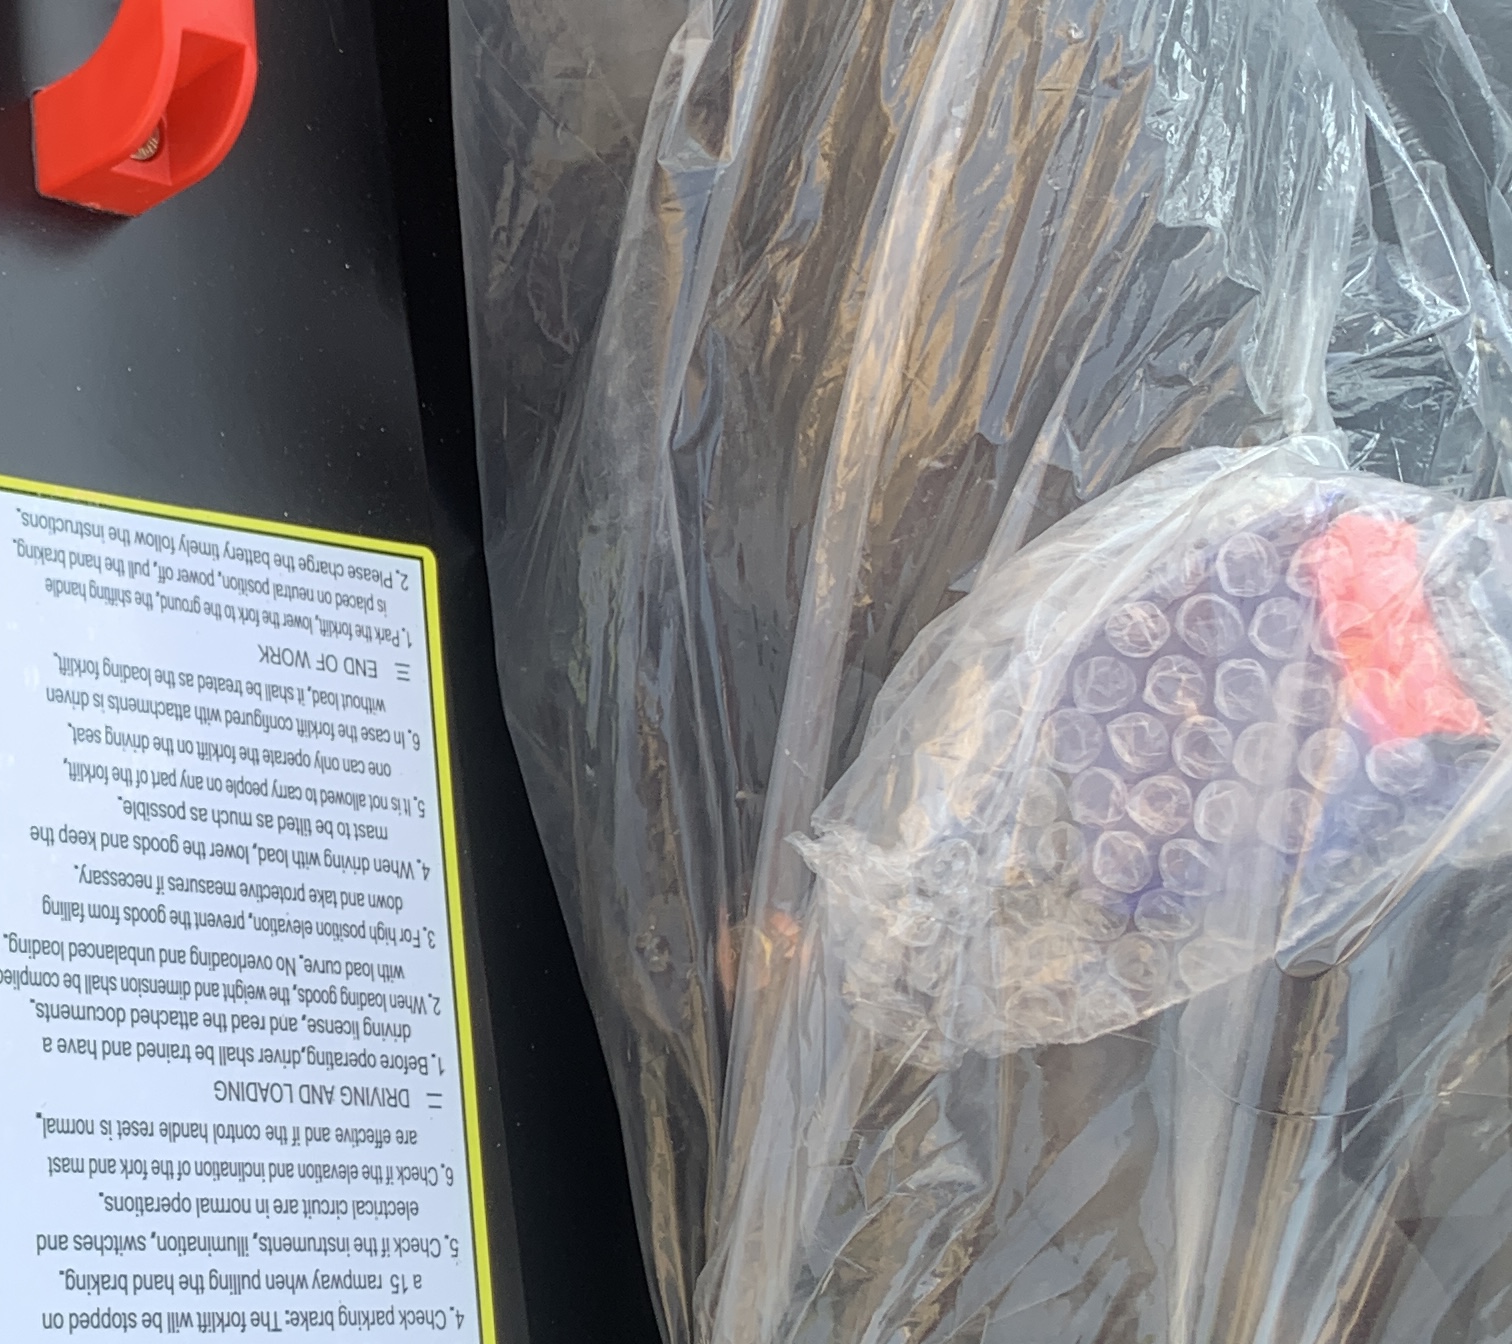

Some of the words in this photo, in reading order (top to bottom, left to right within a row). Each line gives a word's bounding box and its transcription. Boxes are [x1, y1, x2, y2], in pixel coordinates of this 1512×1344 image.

[15, 507, 105, 544] instructions.
[107, 525, 130, 547] the
[133, 530, 175, 555] follow
[177, 533, 220, 561] timely
[222, 540, 270, 570] battery
[272, 552, 295, 573] the
[297, 553, 344, 580] charge
[347, 563, 392, 589] Please
[394, 568, 408, 591] 2.
[256, 643, 311, 669] WORK
[315, 652, 338, 673] OF
[342, 656, 377, 678] END
[73, 863, 152, 889] necessary.
[154, 874, 164, 895] if
[166, 875, 236, 896] measures
[238, 881, 305, 904] protective
[308, 887, 337, 908] take
[339, 890, 365, 910] and
[366, 892, 403, 914] down
[2, 931, 64, 961] loading.
[67, 941, 155, 966] unbalanced
[158, 947, 186, 967] and
[188, 944, 273, 973] overloading
[275, 955, 296, 977] No
[298, 953, 342, 975] curve.
[344, 960, 375, 982] load
[376, 962, 405, 983] with
[28, 997, 126, 1028] documents.
[129, 1007, 198, 1030] attached
[201, 1011, 227, 1033] the
[230, 1013, 265, 1033] read
[268, 1013, 298, 1035] and
[300, 1013, 360, 1040] license,
[362, 1015, 411, 1043] driving
[41, 1036, 52, 1052] a
[56, 1037, 97, 1060] have
[100, 1039, 132, 1060] and
[135, 1041, 192, 1063] trained
[194, 1043, 215, 1065] be
[217, 1045, 254, 1067] shall
[379, 1053, 428, 1075] Before
[430, 1052, 445, 1076] 1.
[212, 1079, 293, 1103] LOADING
[297, 1083, 335, 1105] AND
[339, 1084, 410, 1108] DRIVING
[34, 1111, 94, 1138] normal.
[98, 1118, 112, 1141] is
[115, 1119, 154, 1140] reset
[158, 1120, 208, 1143] handle
[212, 1122, 260, 1144] control
[264, 1124, 288, 1145] the
[290, 1125, 300, 1146] if
[304, 1125, 331, 1147] and
[334, 1126, 391, 1149] effective
[394, 1128, 417, 1145] are
[97, 1190, 192, 1217] operations.
[194, 1196, 251, 1218] normal
[254, 1197, 269, 1219] in
[272, 1197, 299, 1214] are
[300, 1198, 348, 1220] circuit
[351, 1199, 419, 1221] electrical
[35, 1233, 68, 1255] and
[72, 1233, 146, 1256] switches
[149, 1230, 249, 1257] illumination,
[251, 1231, 350, 1257] instruments,
[352, 1236, 378, 1257] the
[380, 1236, 390, 1258] if
[392, 1236, 441, 1258] Check
[443, 1233, 459, 1258] 5.
[58, 1267, 128, 1295] braking.
[132, 1272, 174, 1295] hand
[177, 1273, 205, 1295] the
[208, 1267, 261, 1295] pulling
[264, 1273, 309, 1295] when
[310, 1267, 382, 1290] rampway
[389, 1273, 408, 1294] 15
[412, 1273, 422, 1289] a
[41, 1311, 64, 1329] on
[68, 1306, 137, 1335] stopped
[140, 1311, 162, 1333] be
[166, 1311, 194, 1333] will
[195, 1310, 247, 1333] forklift
[249, 1310, 282, 1332] The
[284, 1309, 334, 1331] brake:
[337, 1299, 395, 1331] parking
[397, 1308, 446, 1330] Check
[448, 1305, 464, 1329] 4.
